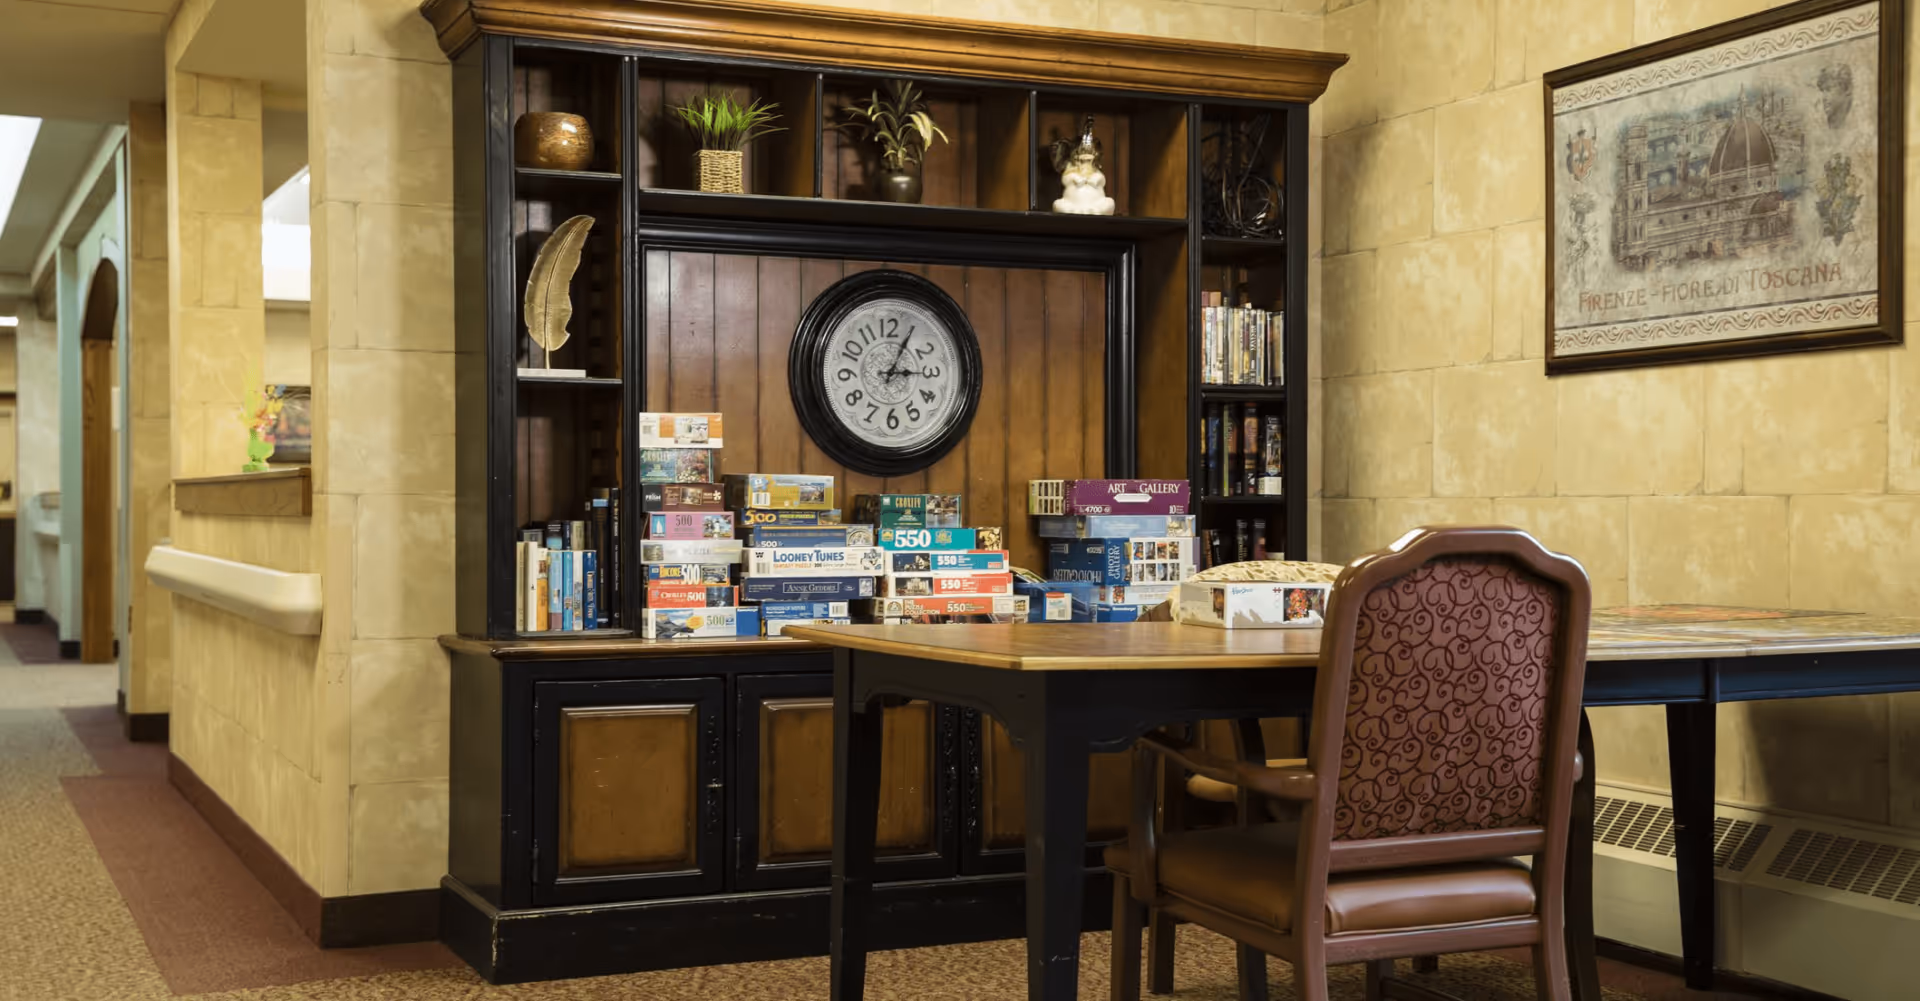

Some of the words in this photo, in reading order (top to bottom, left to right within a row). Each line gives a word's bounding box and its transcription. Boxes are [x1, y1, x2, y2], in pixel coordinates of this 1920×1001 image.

[1579, 288, 1647, 313] FIRENZE
[1746, 262, 1843, 291] TOSCANA
[858, 323, 877, 345] 11
[879, 318, 899, 338] 12
[842, 340, 863, 362] 10
[915, 342, 934, 360] 2
[837, 368, 858, 382] 9
[922, 365, 940, 380] 3
[845, 389, 863, 406] 8
[919, 388, 936, 405] 4
[863, 401, 880, 424] 7
[886, 408, 900, 430] 6
[906, 400, 921, 422] 5
[1108, 483, 1127, 494] ART
[1139, 483, 1181, 494] GALLERY
[675, 515, 693, 526] 500
[744, 510, 777, 525] 500
[895, 529, 931, 548] 550
[773, 550, 813, 563] LOONEY
[814, 549, 845, 562] TUNES
[937, 555, 957, 566] 550
[1113, 545, 1121, 579] GALLERY
[680, 563, 700, 586] 500
[941, 579, 961, 590] 550
[686, 591, 705, 601] 500
[947, 603, 966, 612] 550
[706, 615, 725, 626] 500
